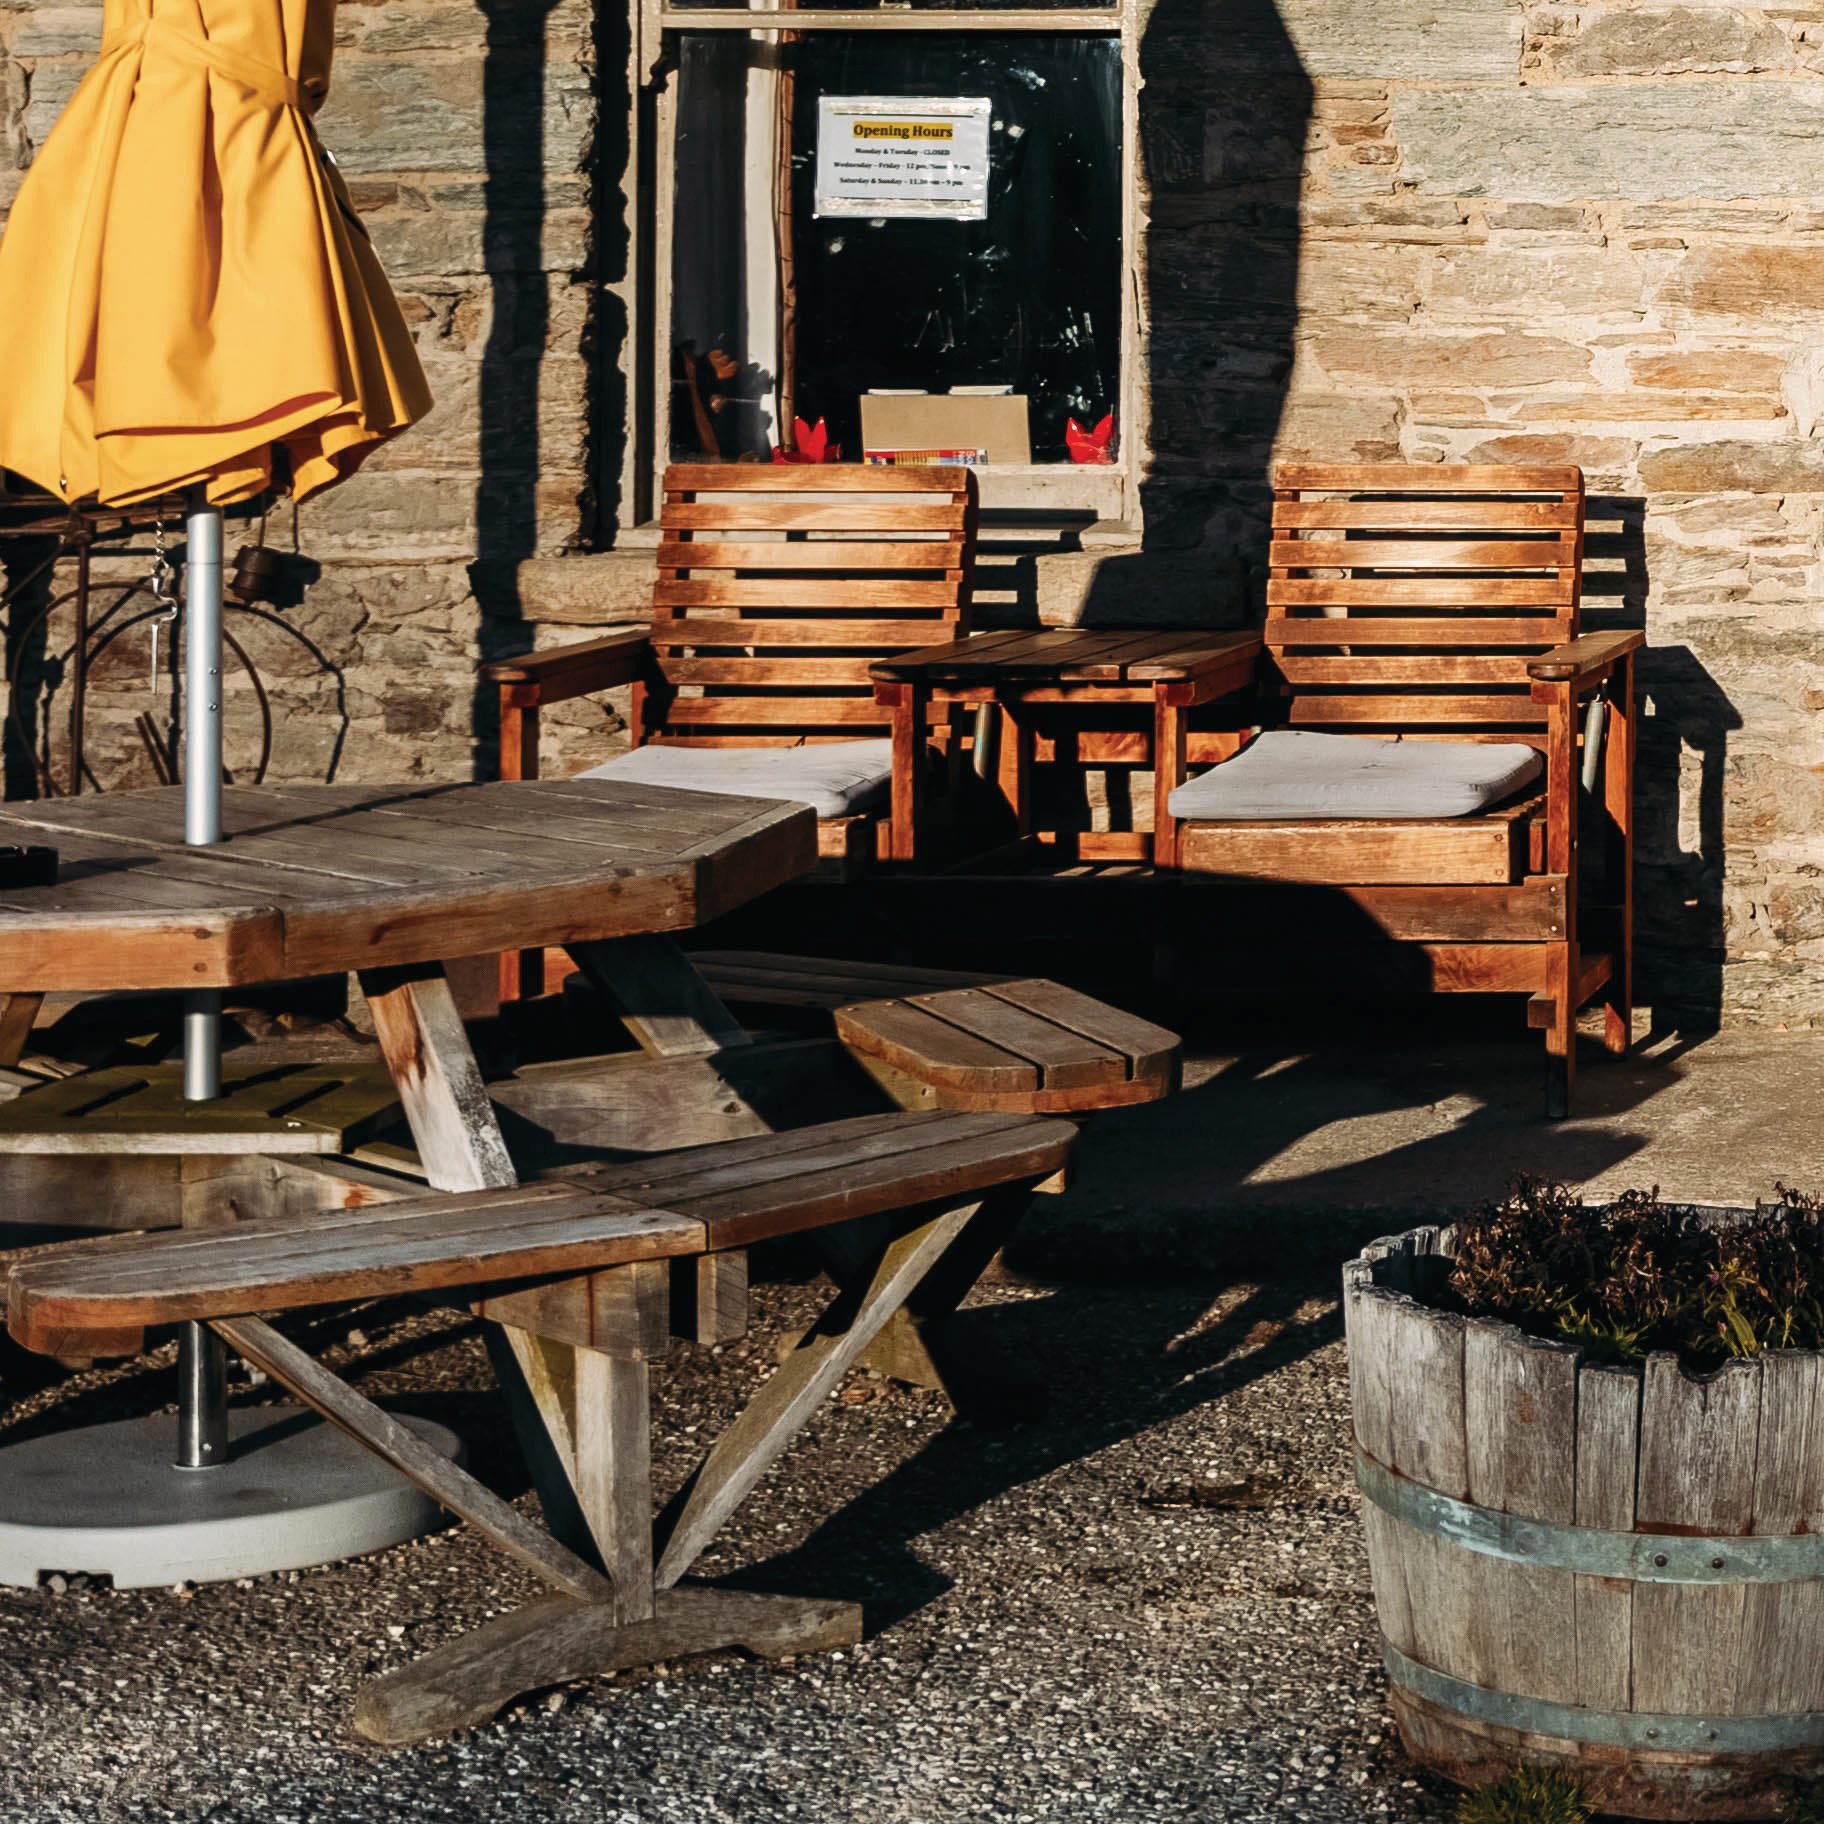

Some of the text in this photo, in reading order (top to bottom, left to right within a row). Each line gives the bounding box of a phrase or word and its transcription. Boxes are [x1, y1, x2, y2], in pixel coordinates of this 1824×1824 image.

[853, 124, 953, 139] Opening Hours
[890, 148, 918, 156] Tuesday
[833, 162, 872, 170] Wednesday
[878, 162, 901, 170] Friday
[839, 177, 870, 186] Saturday
[877, 178, 903, 186] Sunday
